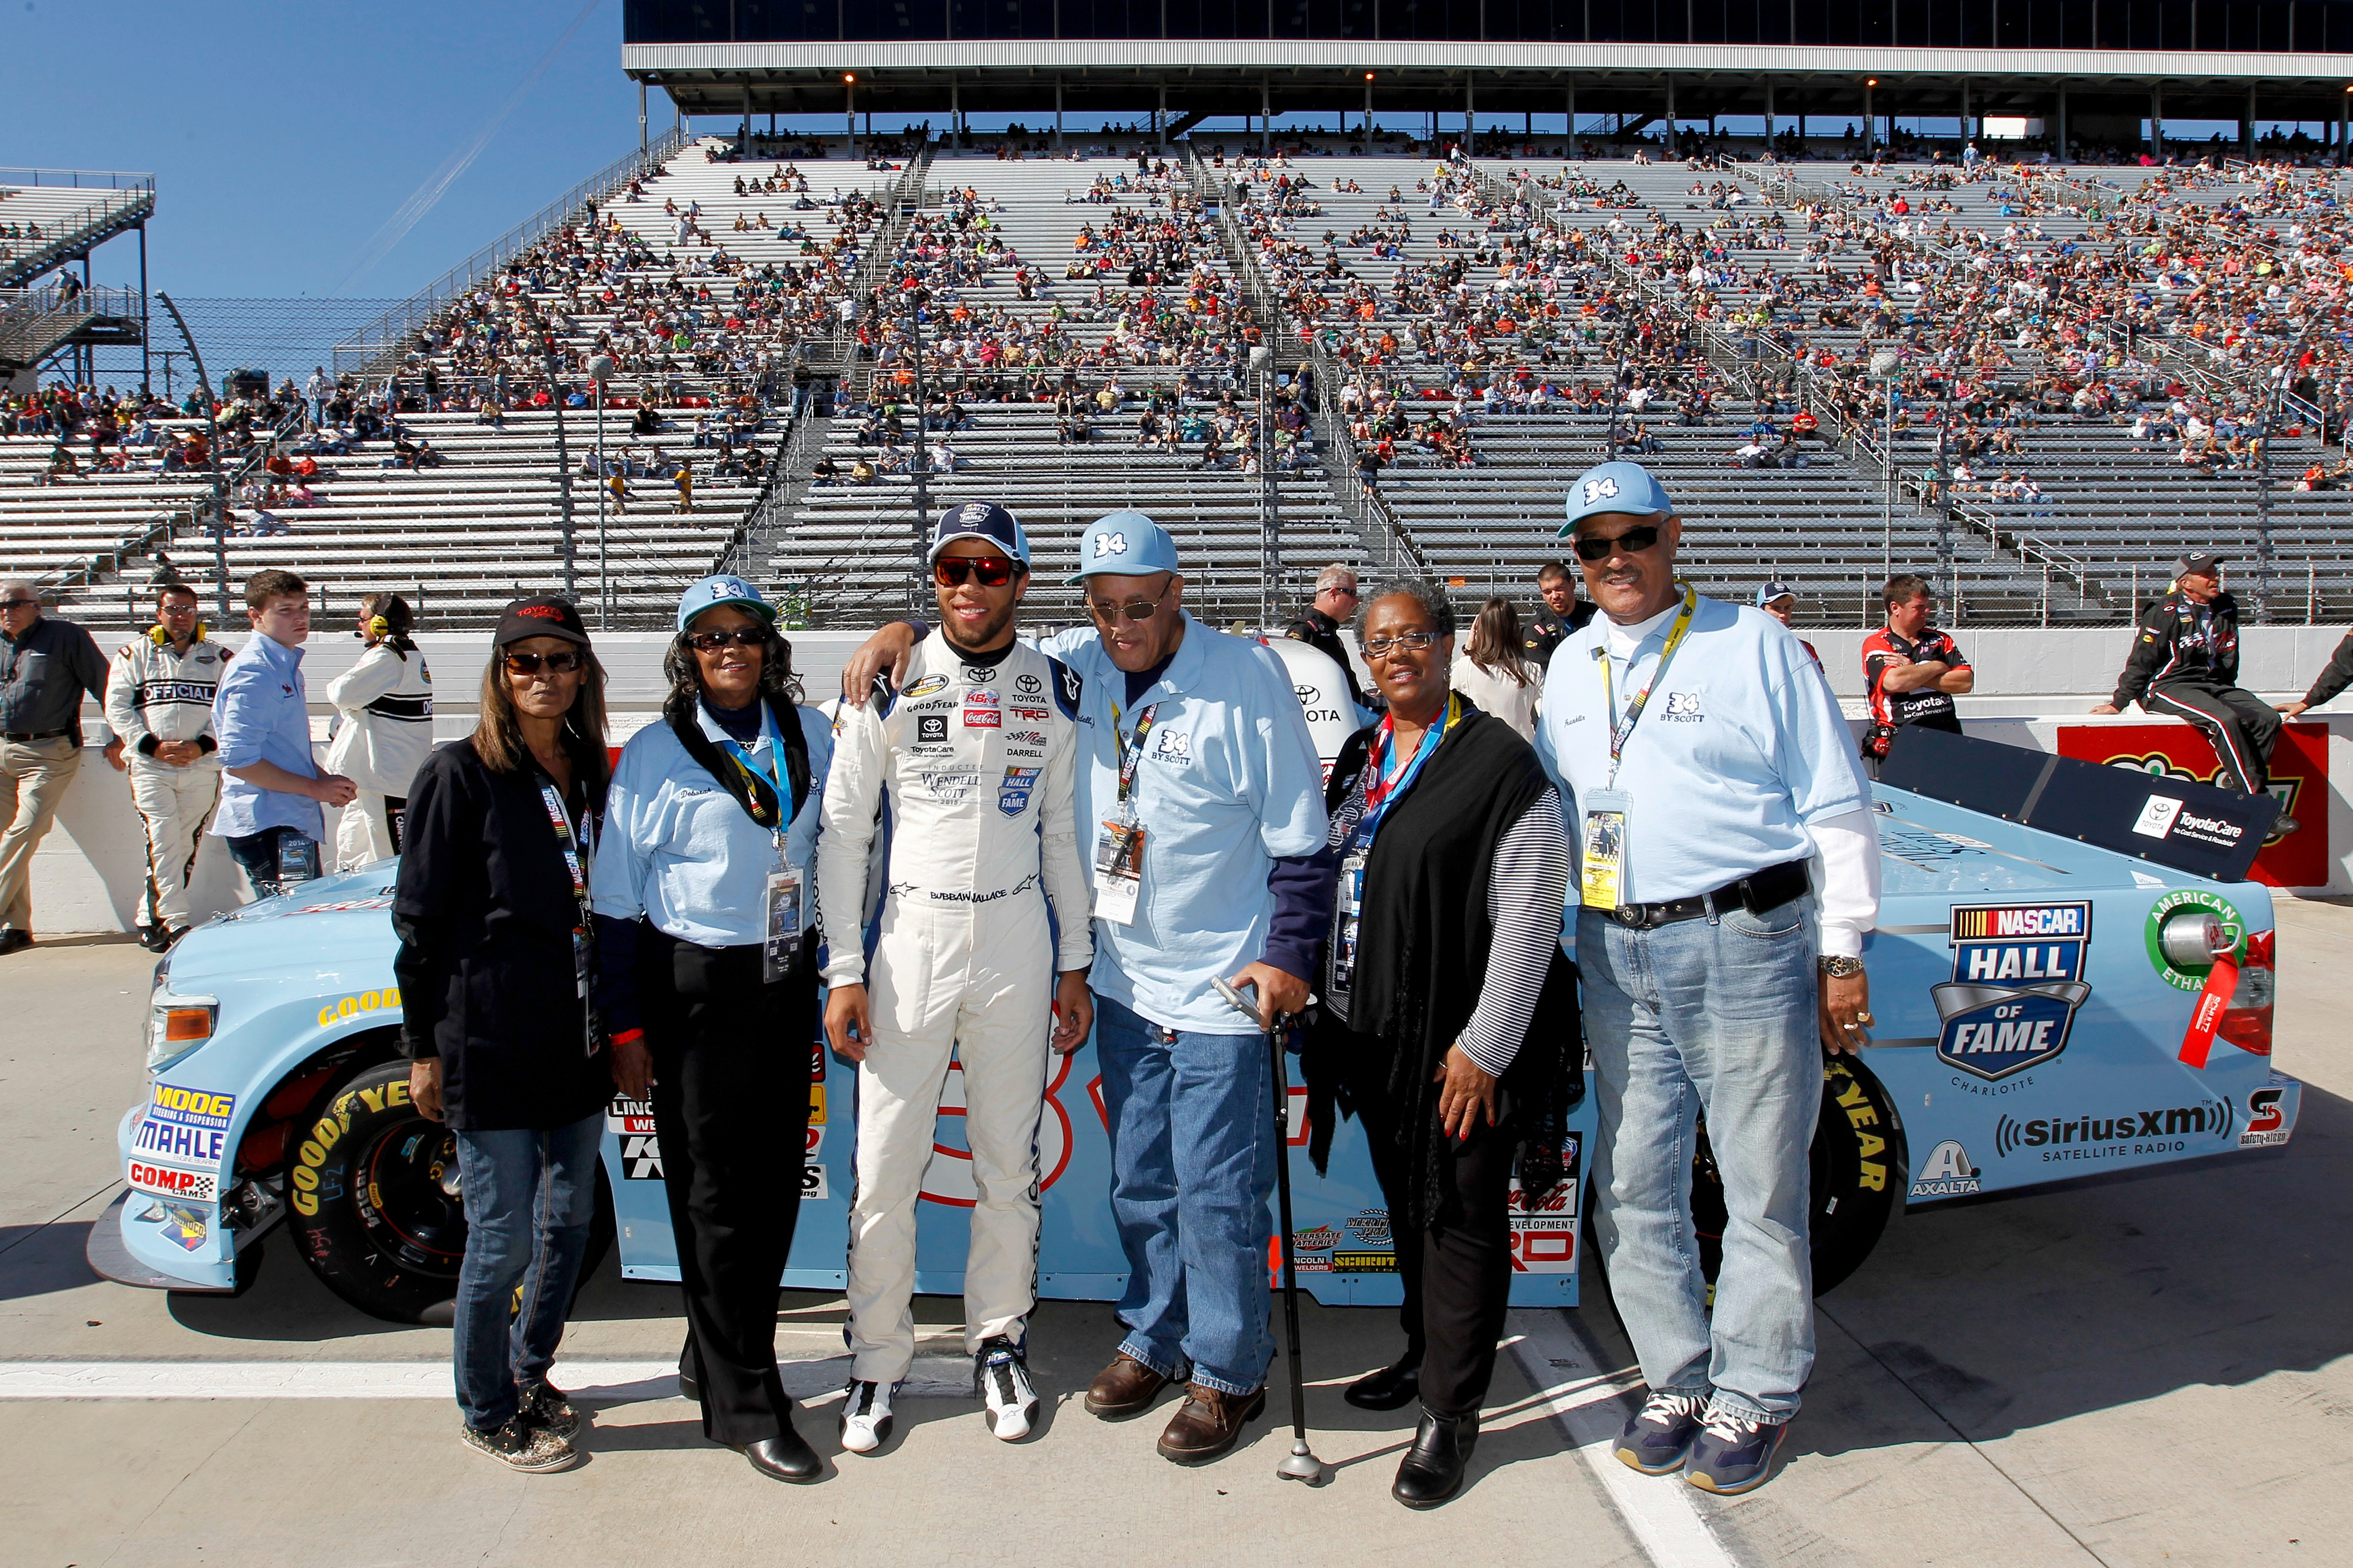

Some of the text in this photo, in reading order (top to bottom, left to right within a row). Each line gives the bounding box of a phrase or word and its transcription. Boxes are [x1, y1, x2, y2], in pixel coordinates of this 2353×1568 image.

[1583, 477, 1620, 507] 34
[1094, 532, 1127, 559] 34
[711, 581, 747, 599] 34
[517, 606, 562, 617] TOYOTA
[144, 685, 214, 701] OFFICIAL
[966, 694, 997, 704] KBM
[1012, 695, 1046, 704] TOYOTA
[907, 700, 959, 712] GOODYEAR
[1666, 692, 1699, 714] 34
[965, 711, 1000, 724] Coca-Cola
[1009, 708, 1049, 721] TRD
[1306, 710, 1341, 722] OTA
[1564, 715, 1586, 728] Franklin
[1660, 714, 1705, 722] BY SCOTT
[1158, 729, 1188, 756] 34
[1612, 718, 1636, 753] NASCAR
[911, 745, 955, 754] ToyotaCare
[1007, 748, 1043, 758] DARRELL
[1151, 751, 1191, 765] BY SCOTT
[1122, 747, 1141, 781] NASCAR
[922, 773, 982, 787] WENDELL
[1006, 778, 1030, 787] HALL
[929, 786, 967, 798] SCOTT
[543, 788, 564, 823] NASCAR
[1001, 798, 1025, 808] FAME
[580, 810, 590, 844] NASCAR
[2142, 820, 2164, 831] TOYOTA
[2179, 811, 2242, 838] ToyotaCare
[2180, 829, 2190, 837] Cost
[2190, 831, 2208, 841] Service
[2212, 836, 2236, 847] Roadside
[1109, 850, 1131, 865] HT
[565, 851, 583, 885] NASCAR
[930, 891, 963, 901] BUBBA
[813, 872, 828, 944] TOYOTA
[2152, 891, 2236, 923] AMERICAN
[1998, 909, 2077, 935] NASCAR
[1968, 946, 2067, 980] HALL
[2162, 967, 2207, 991] ETHA
[317, 988, 402, 1027] GOOD
[1994, 1005, 2023, 1019] OF
[2201, 996, 2221, 1033] SCHULTZ
[1951, 1020, 2055, 1055] FAME
[1951, 1076, 2034, 1096] CHARLOTTE
[154, 1085, 234, 1118] MOOG
[612, 1101, 654, 1116] LINC
[153, 1106, 228, 1129] STEERING & SUSPENSION
[135, 1121, 224, 1160] MAHLE
[1835, 1080, 1886, 1192] YEAR
[173, 1154, 194, 1164] ENGINE
[2042, 1141, 2185, 1162] SATELLITE RADIO
[131, 1163, 195, 1189] COMP
[173, 1187, 207, 1199] CAMS
[370, 1184, 382, 1207] Bassett
[1909, 1179, 1981, 1196] AXALTA
[173, 1213, 205, 1236] SUNOCO
[1345, 1218, 1390, 1228] MERIT
[1293, 1232, 1343, 1240] NTERSTATE
[1361, 1228, 1388, 1238] PRO
[1510, 1231, 1574, 1272] RD
[1334, 1257, 1397, 1267] SCHROT
